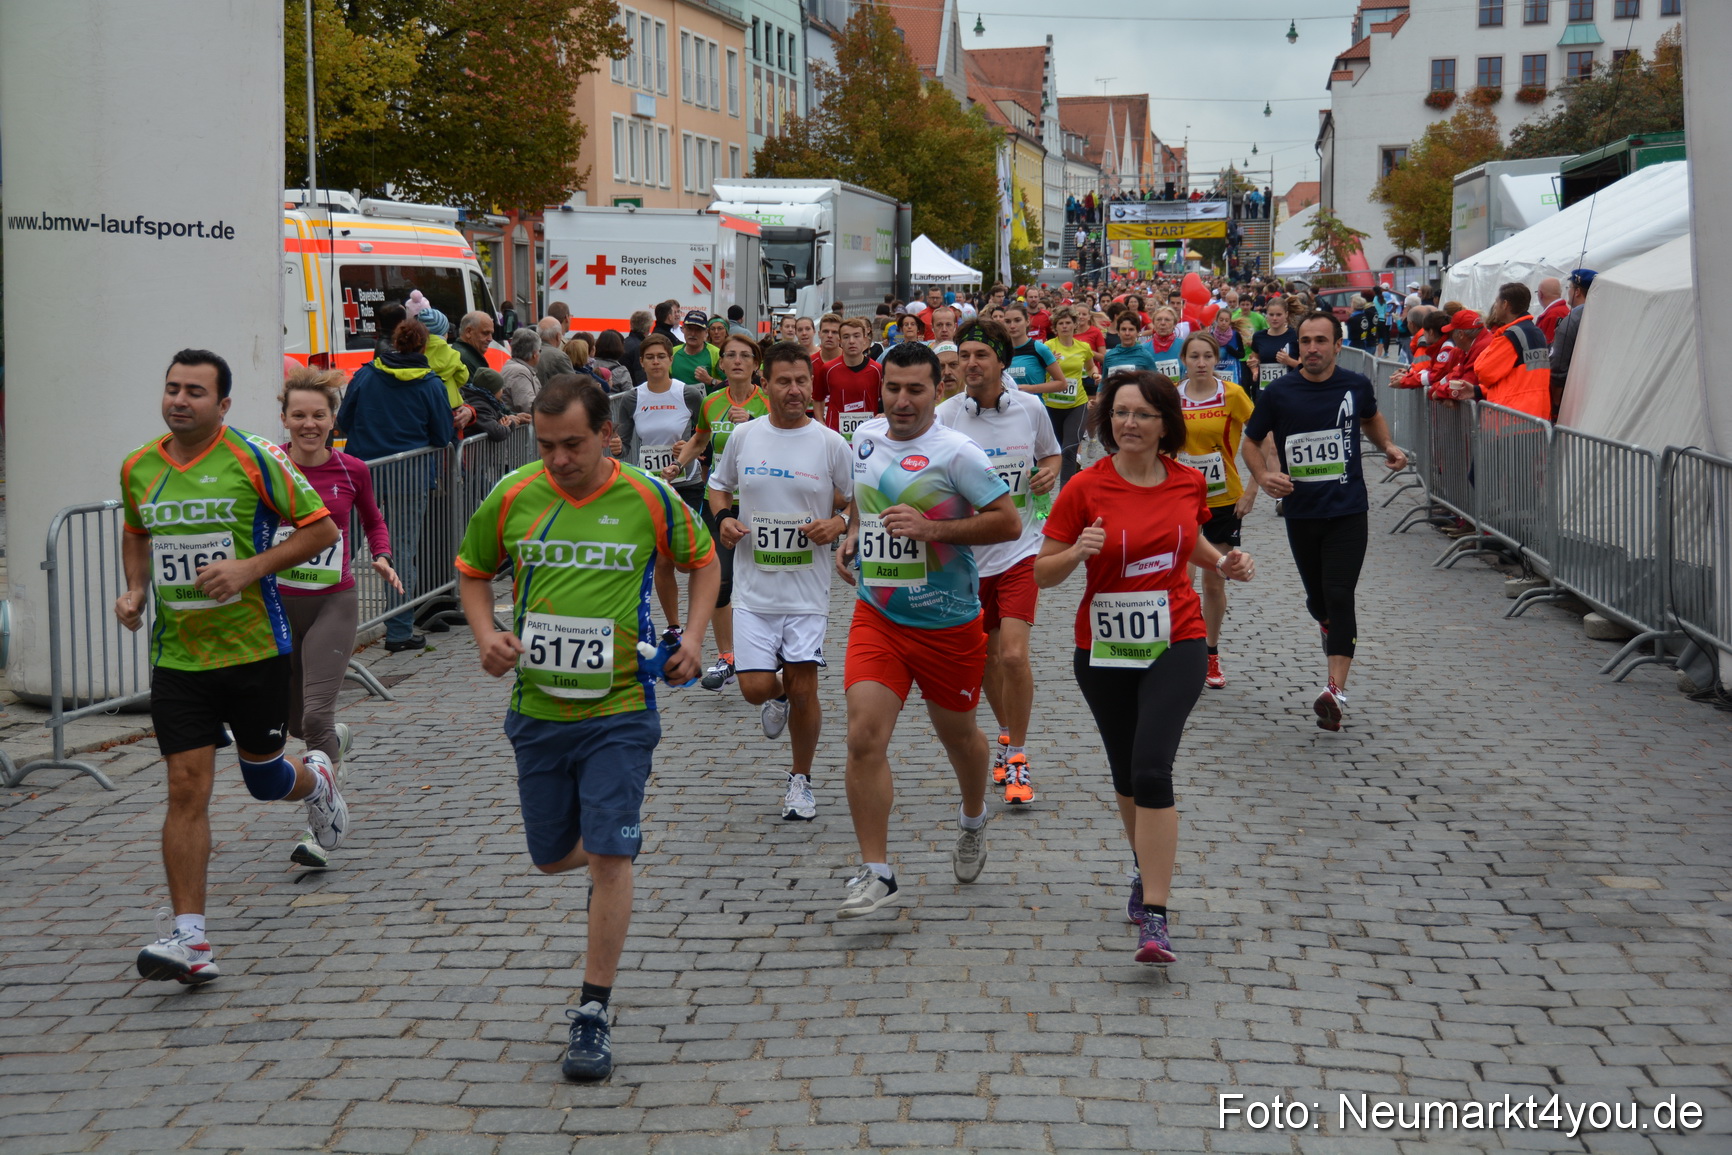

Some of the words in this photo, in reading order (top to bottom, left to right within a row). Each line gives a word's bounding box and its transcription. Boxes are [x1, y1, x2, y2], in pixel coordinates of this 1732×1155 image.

[8, 211, 235, 240] www.bmw-laufsport.de
[1145, 225, 1187, 237] START
[621, 255, 677, 266] Bayerisches
[621, 267, 647, 276] Rotes
[914, 273, 951, 282] Laufsport
[621, 278, 647, 288] Kreuz
[1262, 369, 1283, 380] 5151
[1199, 410, 1228, 420] BÖGL
[1292, 442, 1339, 464] 5149
[744, 461, 795, 479] RÖDL
[795, 470, 820, 481] energie
[1305, 467, 1328, 476] Katrin
[140, 500, 236, 527] BOCK
[753, 516, 772, 525] PARTL
[861, 520, 878, 528] PARTL
[757, 526, 809, 549] 5178
[154, 542, 178, 550] PARTL
[180, 541, 219, 550] Neumarkt
[863, 531, 919, 560] 5164
[519, 541, 636, 570] BOCK
[762, 553, 802, 565] Wolfgang
[876, 566, 899, 577] Azad
[1138, 560, 1160, 571] DEHN
[291, 569, 318, 581] Maria
[1115, 600, 1155, 608] Neumarkt
[527, 620, 553, 632] PARTL
[554, 624, 598, 635] Neumarkt
[1097, 610, 1160, 639] 5101
[529, 635, 605, 670] 5173
[1110, 645, 1152, 658] Susanne
[552, 674, 578, 687] Tino
